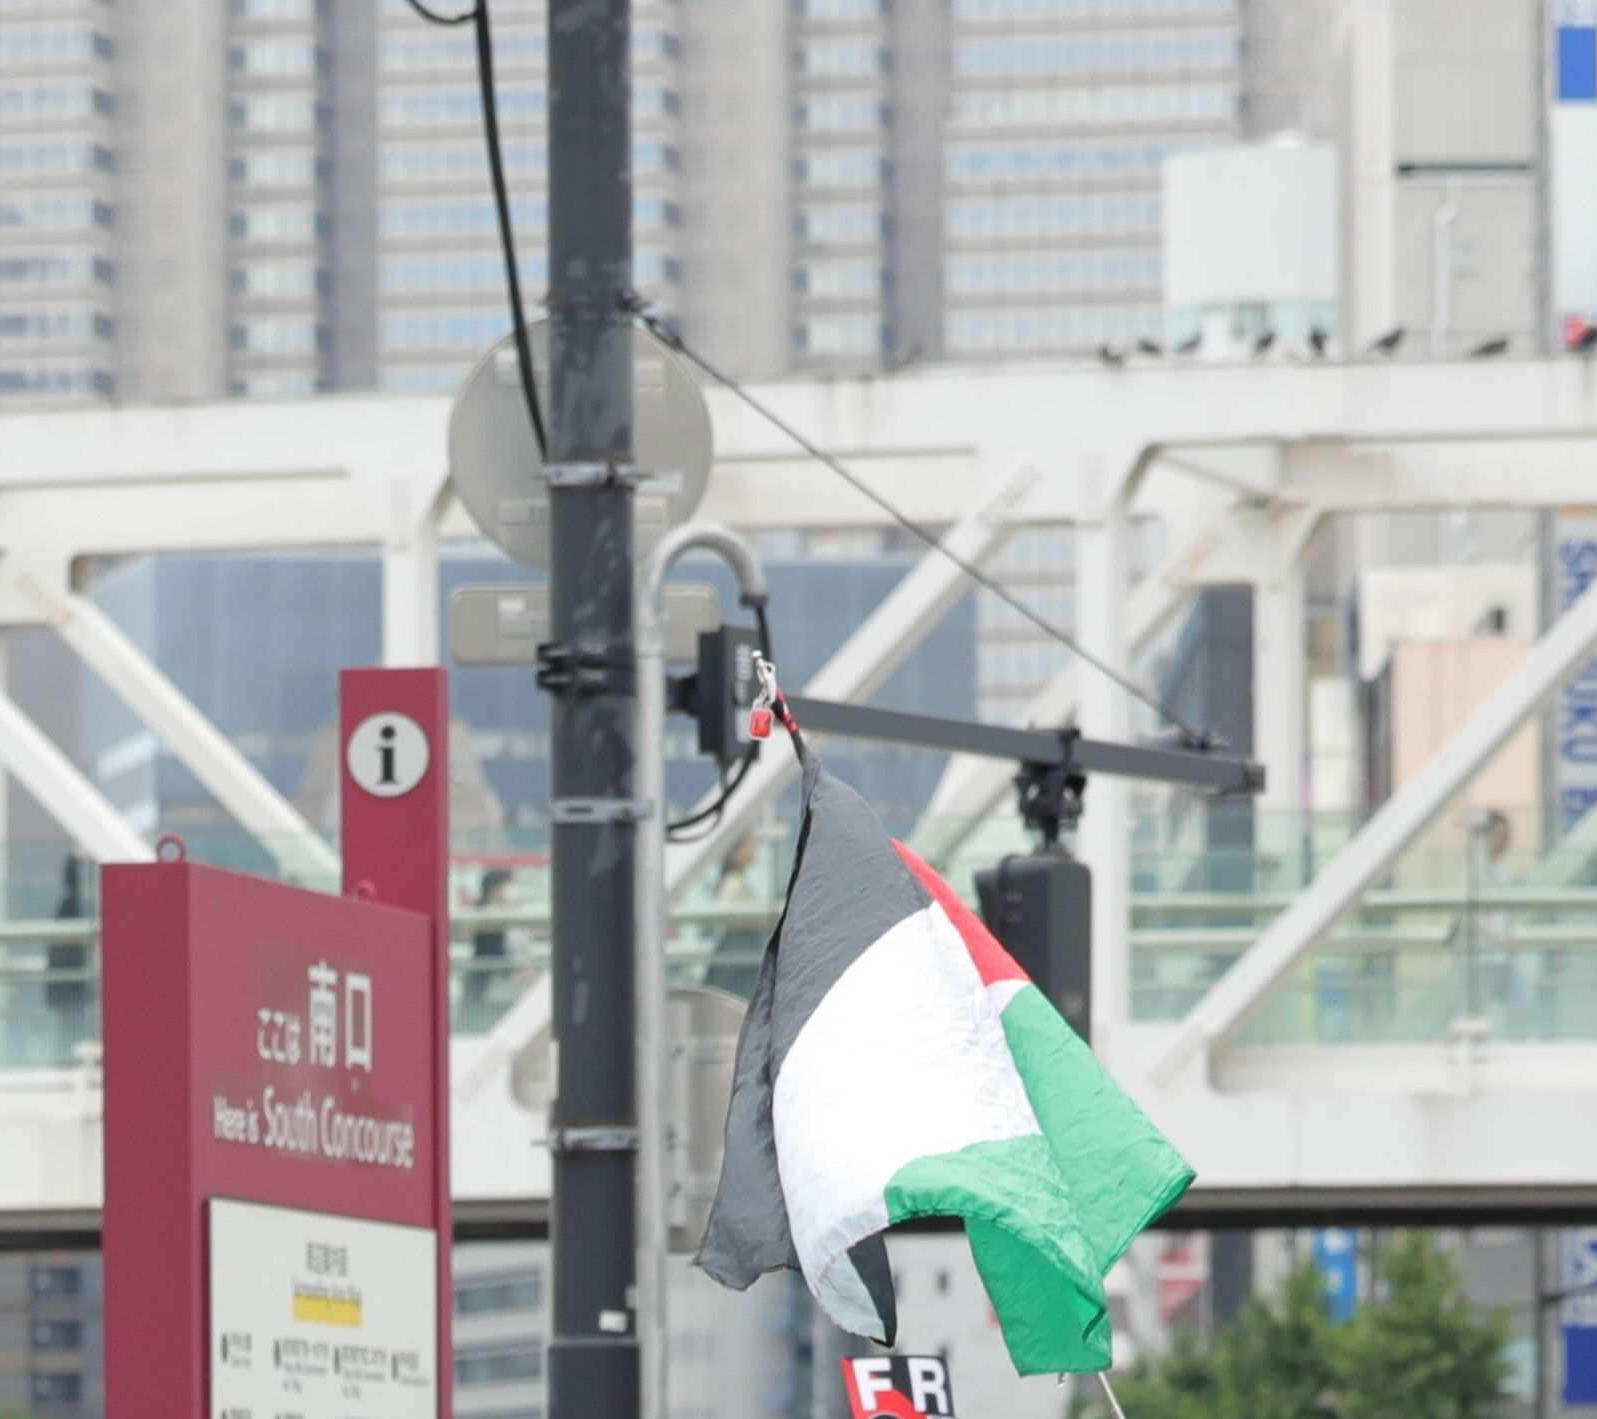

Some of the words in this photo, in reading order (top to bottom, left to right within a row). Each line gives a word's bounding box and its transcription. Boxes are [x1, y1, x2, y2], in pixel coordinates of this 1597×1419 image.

[256, 1007, 301, 1065] ここは
[307, 958, 374, 1075] 南口
[212, 1094, 244, 1142] Here
[244, 1102, 260, 1146] is
[261, 1085, 316, 1151] South
[318, 1098, 415, 1171] Concourse
[852, 1356, 949, 1414] FR
